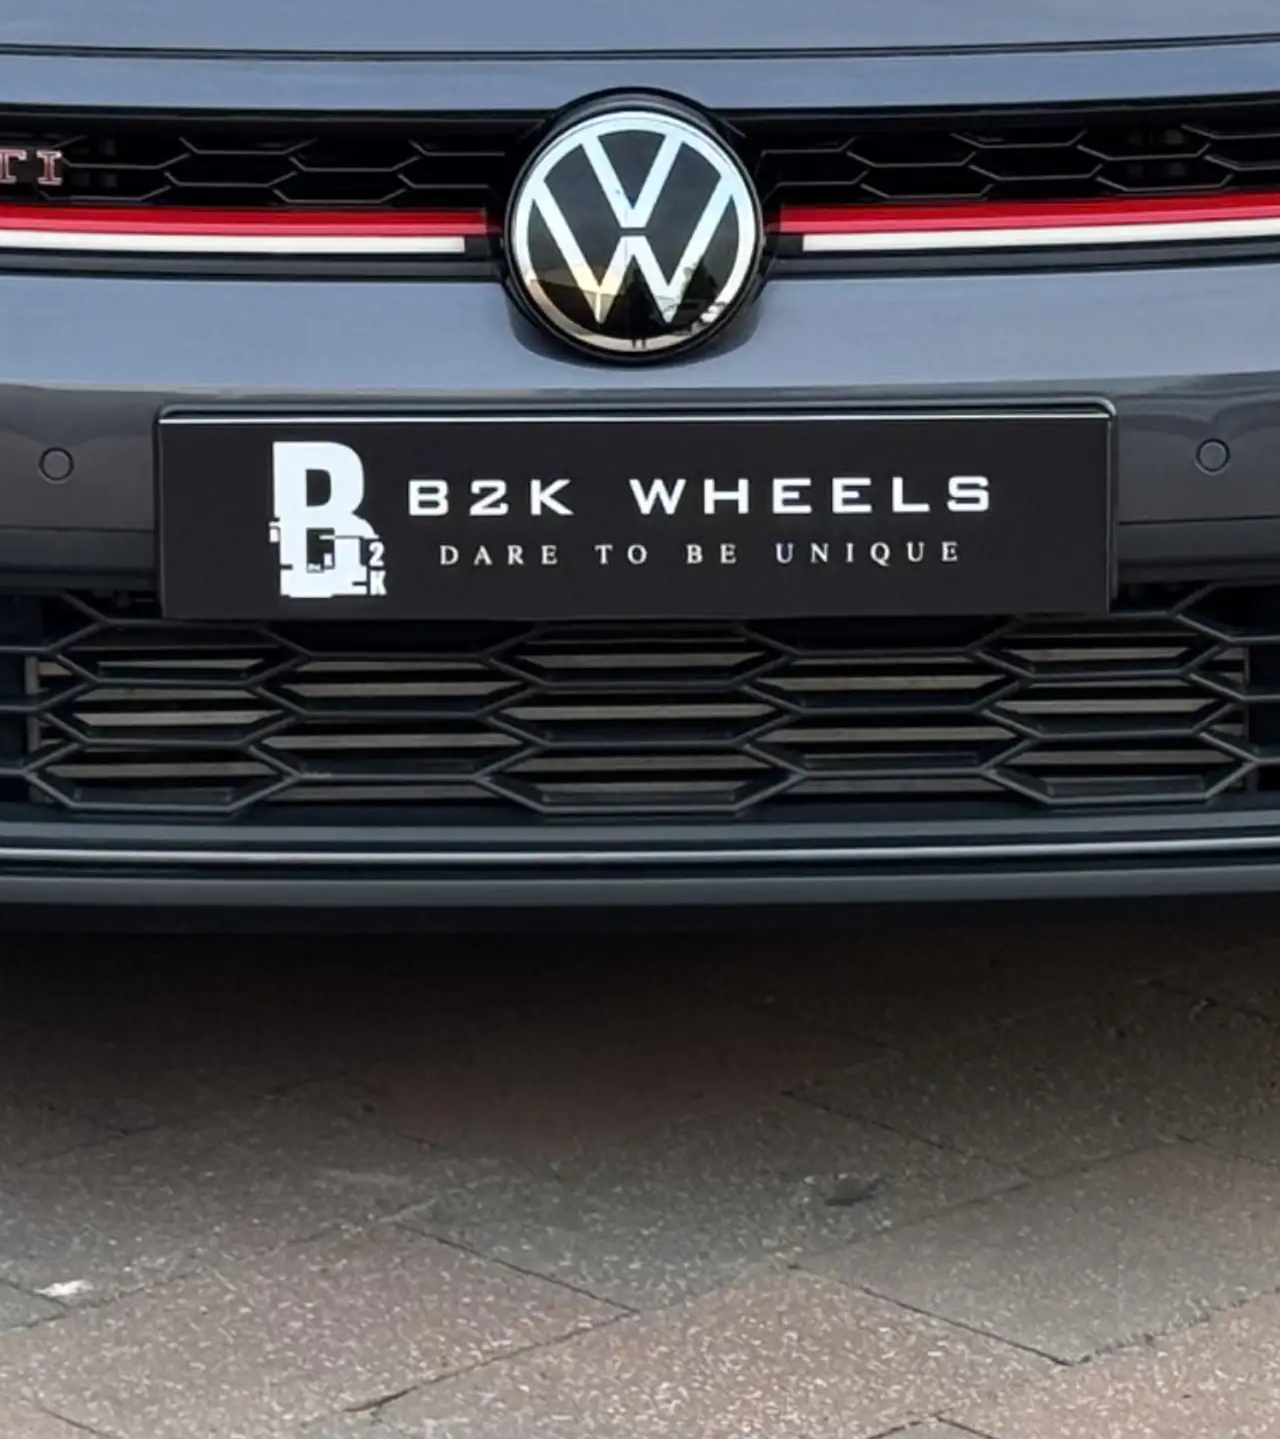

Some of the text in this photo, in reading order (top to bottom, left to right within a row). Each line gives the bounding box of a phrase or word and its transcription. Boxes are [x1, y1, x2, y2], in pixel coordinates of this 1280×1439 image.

[408, 475, 990, 516] B2K WHEELS
[440, 541, 959, 567] DARE TO BE UNIQUE
